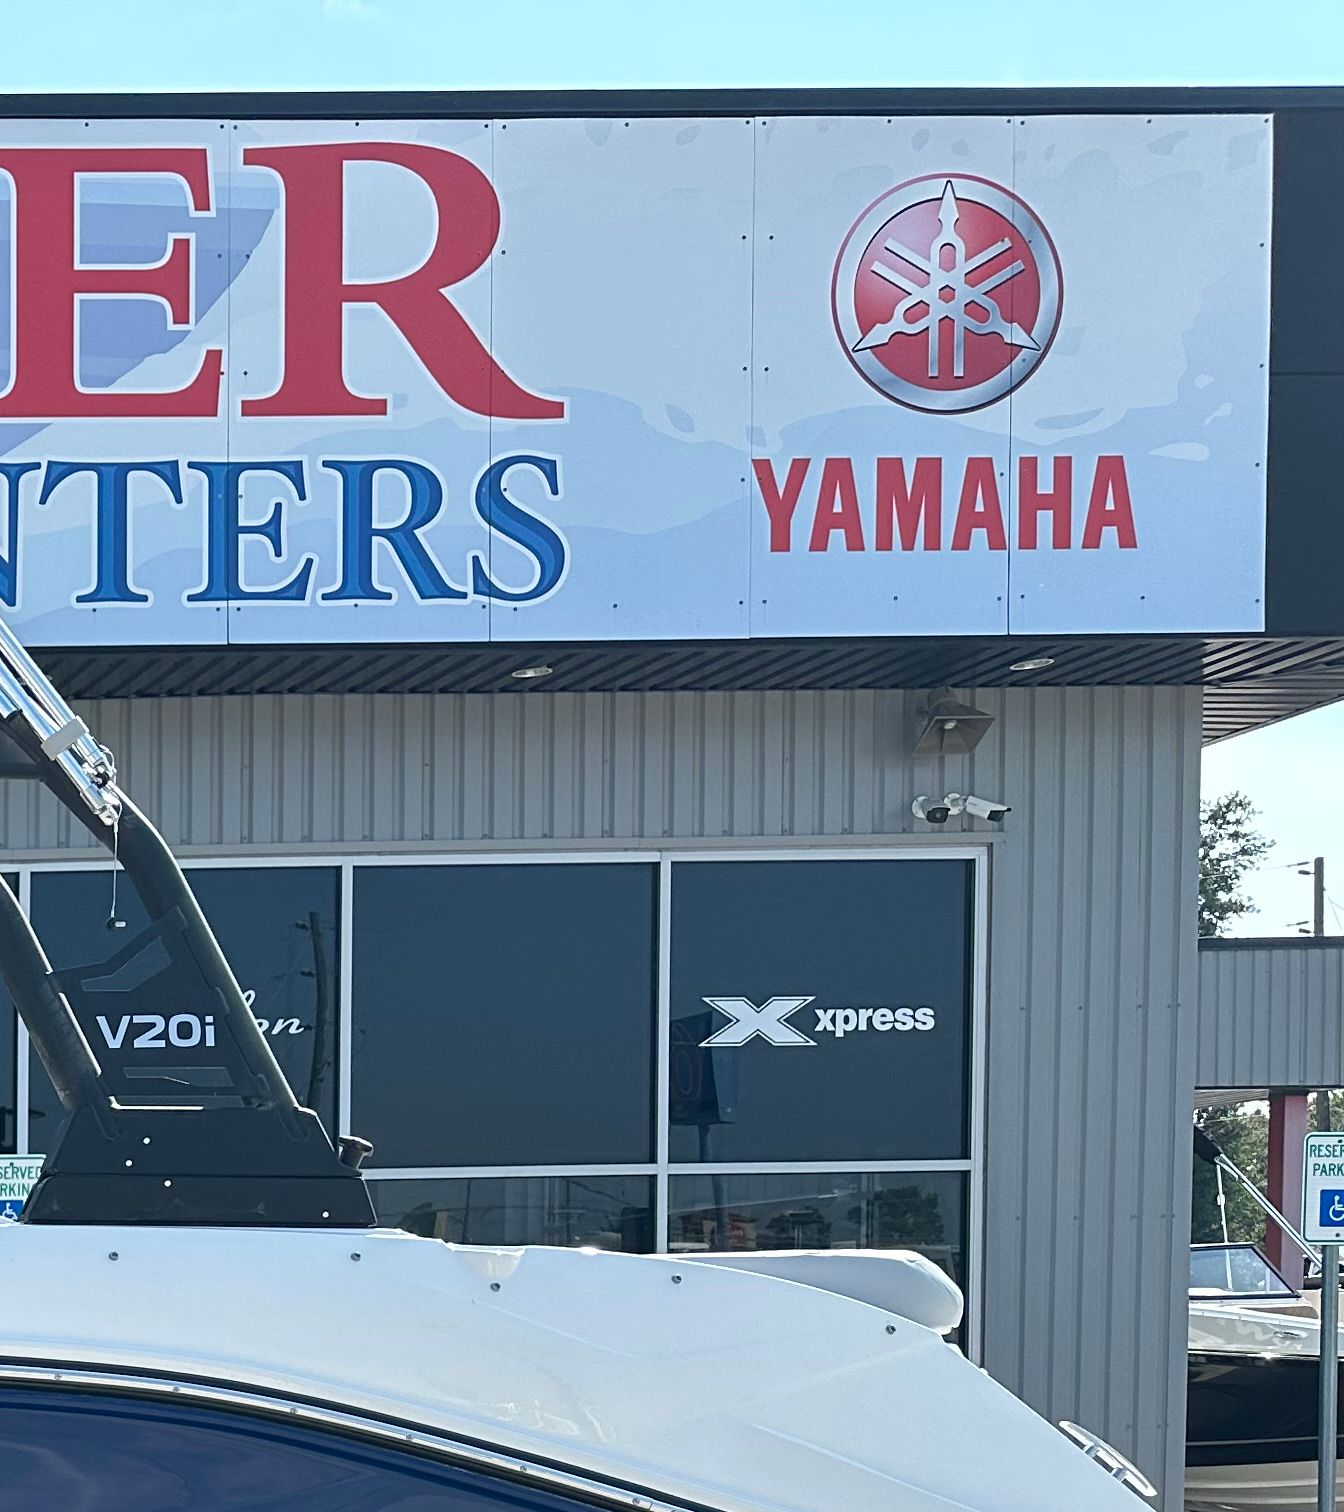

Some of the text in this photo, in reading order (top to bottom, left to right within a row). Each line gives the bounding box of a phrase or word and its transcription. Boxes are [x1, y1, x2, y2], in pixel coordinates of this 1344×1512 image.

[751, 455, 1138, 552] YAMAHA
[95, 1013, 216, 1049] V20i
[814, 1003, 936, 1038] xpress
